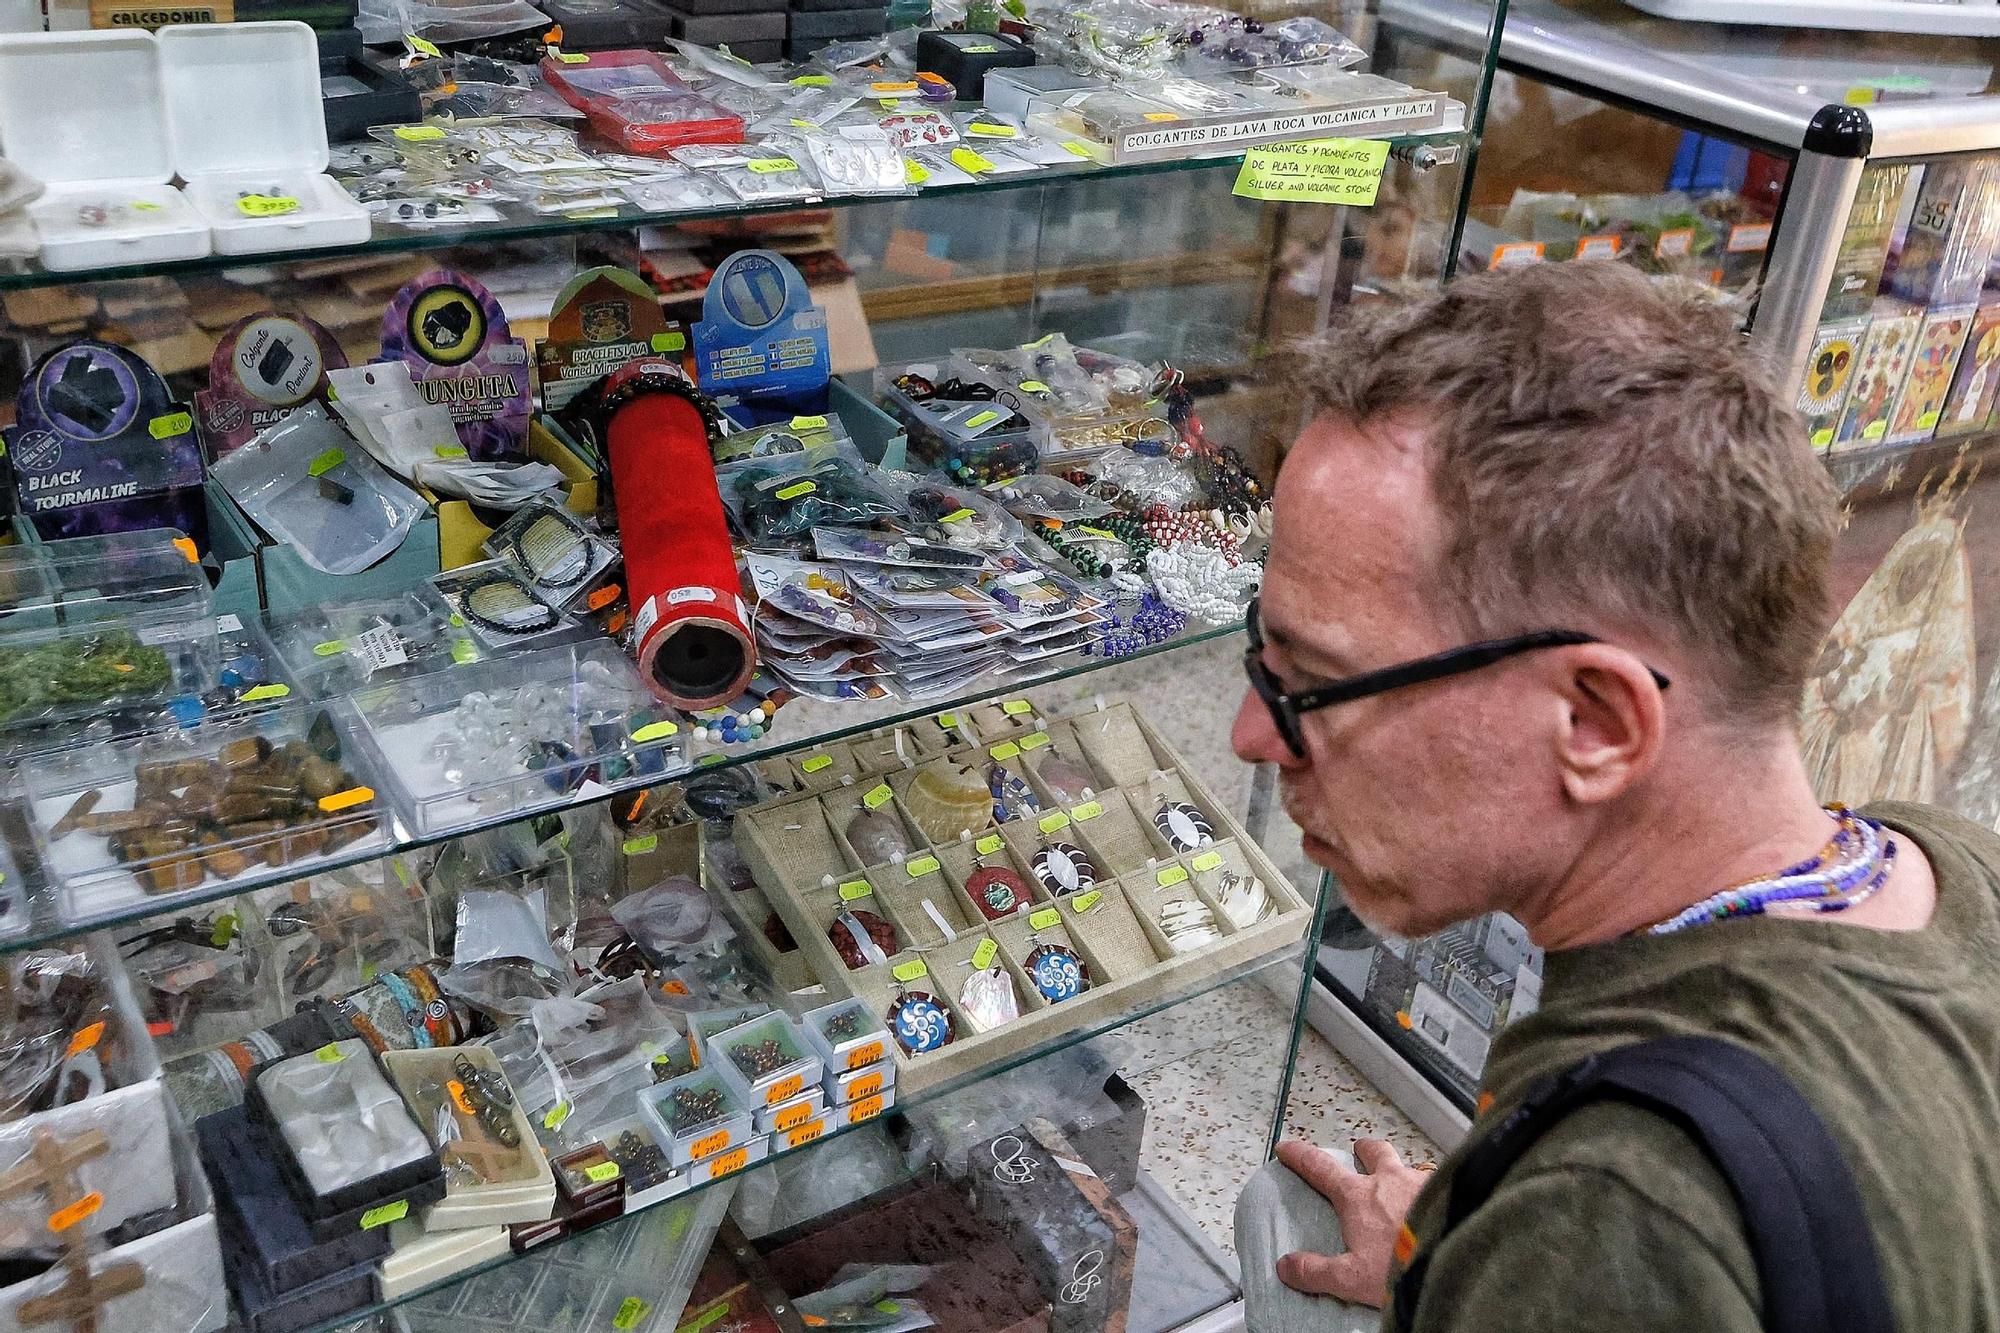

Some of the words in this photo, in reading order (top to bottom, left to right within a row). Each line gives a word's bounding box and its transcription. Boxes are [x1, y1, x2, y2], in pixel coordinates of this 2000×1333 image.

[112, 11, 211, 25] CALCEDONIA
[1127, 130, 1205, 148] COLGANTES
[1211, 126, 1227, 139] DE
[1233, 121, 1267, 136] LAVA
[1273, 117, 1306, 130] ROCA
[1312, 109, 1377, 126] VOLCANICA
[1382, 106, 1391, 117] Y
[1395, 101, 1434, 116] PLATA
[1312, 146, 1320, 157] Y
[1320, 147, 1371, 162] PENDIENTES
[1252, 159, 1265, 170] DE
[1272, 161, 1299, 173] PLATA
[1305, 164, 1311, 173] Y
[1312, 164, 1340, 176] PIEDRA
[1248, 179, 1284, 191] SILVER
[1288, 184, 1304, 192] AND
[1308, 184, 1340, 193] VOLCANIC
[1345, 184, 1372, 194] STONE
[241, 328, 269, 369] Colgante
[285, 355, 314, 396] Pendant
[560, 363, 593, 379] Varied
[252, 407, 299, 425] BLAC
[29, 469, 82, 491] BLACK
[34, 481, 138, 512] TOURMALINE
